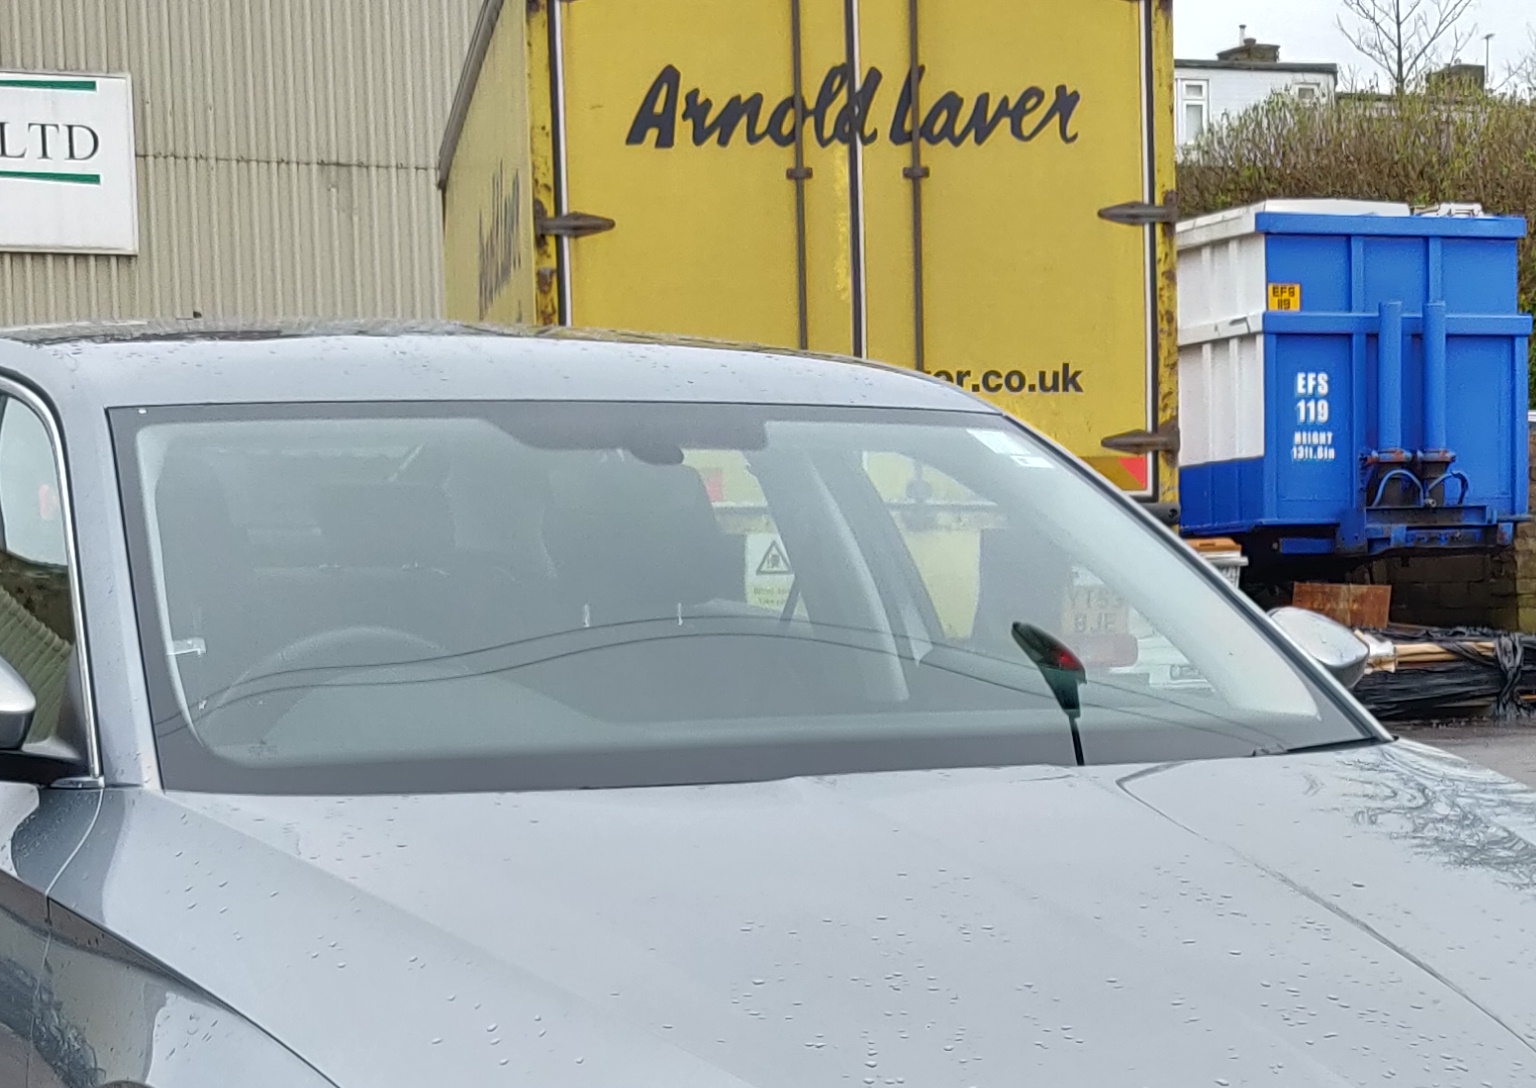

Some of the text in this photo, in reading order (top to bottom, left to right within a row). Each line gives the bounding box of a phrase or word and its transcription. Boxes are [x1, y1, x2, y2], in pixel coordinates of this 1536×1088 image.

[624, 62, 1081, 149] Arnold Laver
[1272, 286, 1296, 298] EFS
[1296, 371, 1330, 396] EFS
[1296, 398, 1330, 423] 119
